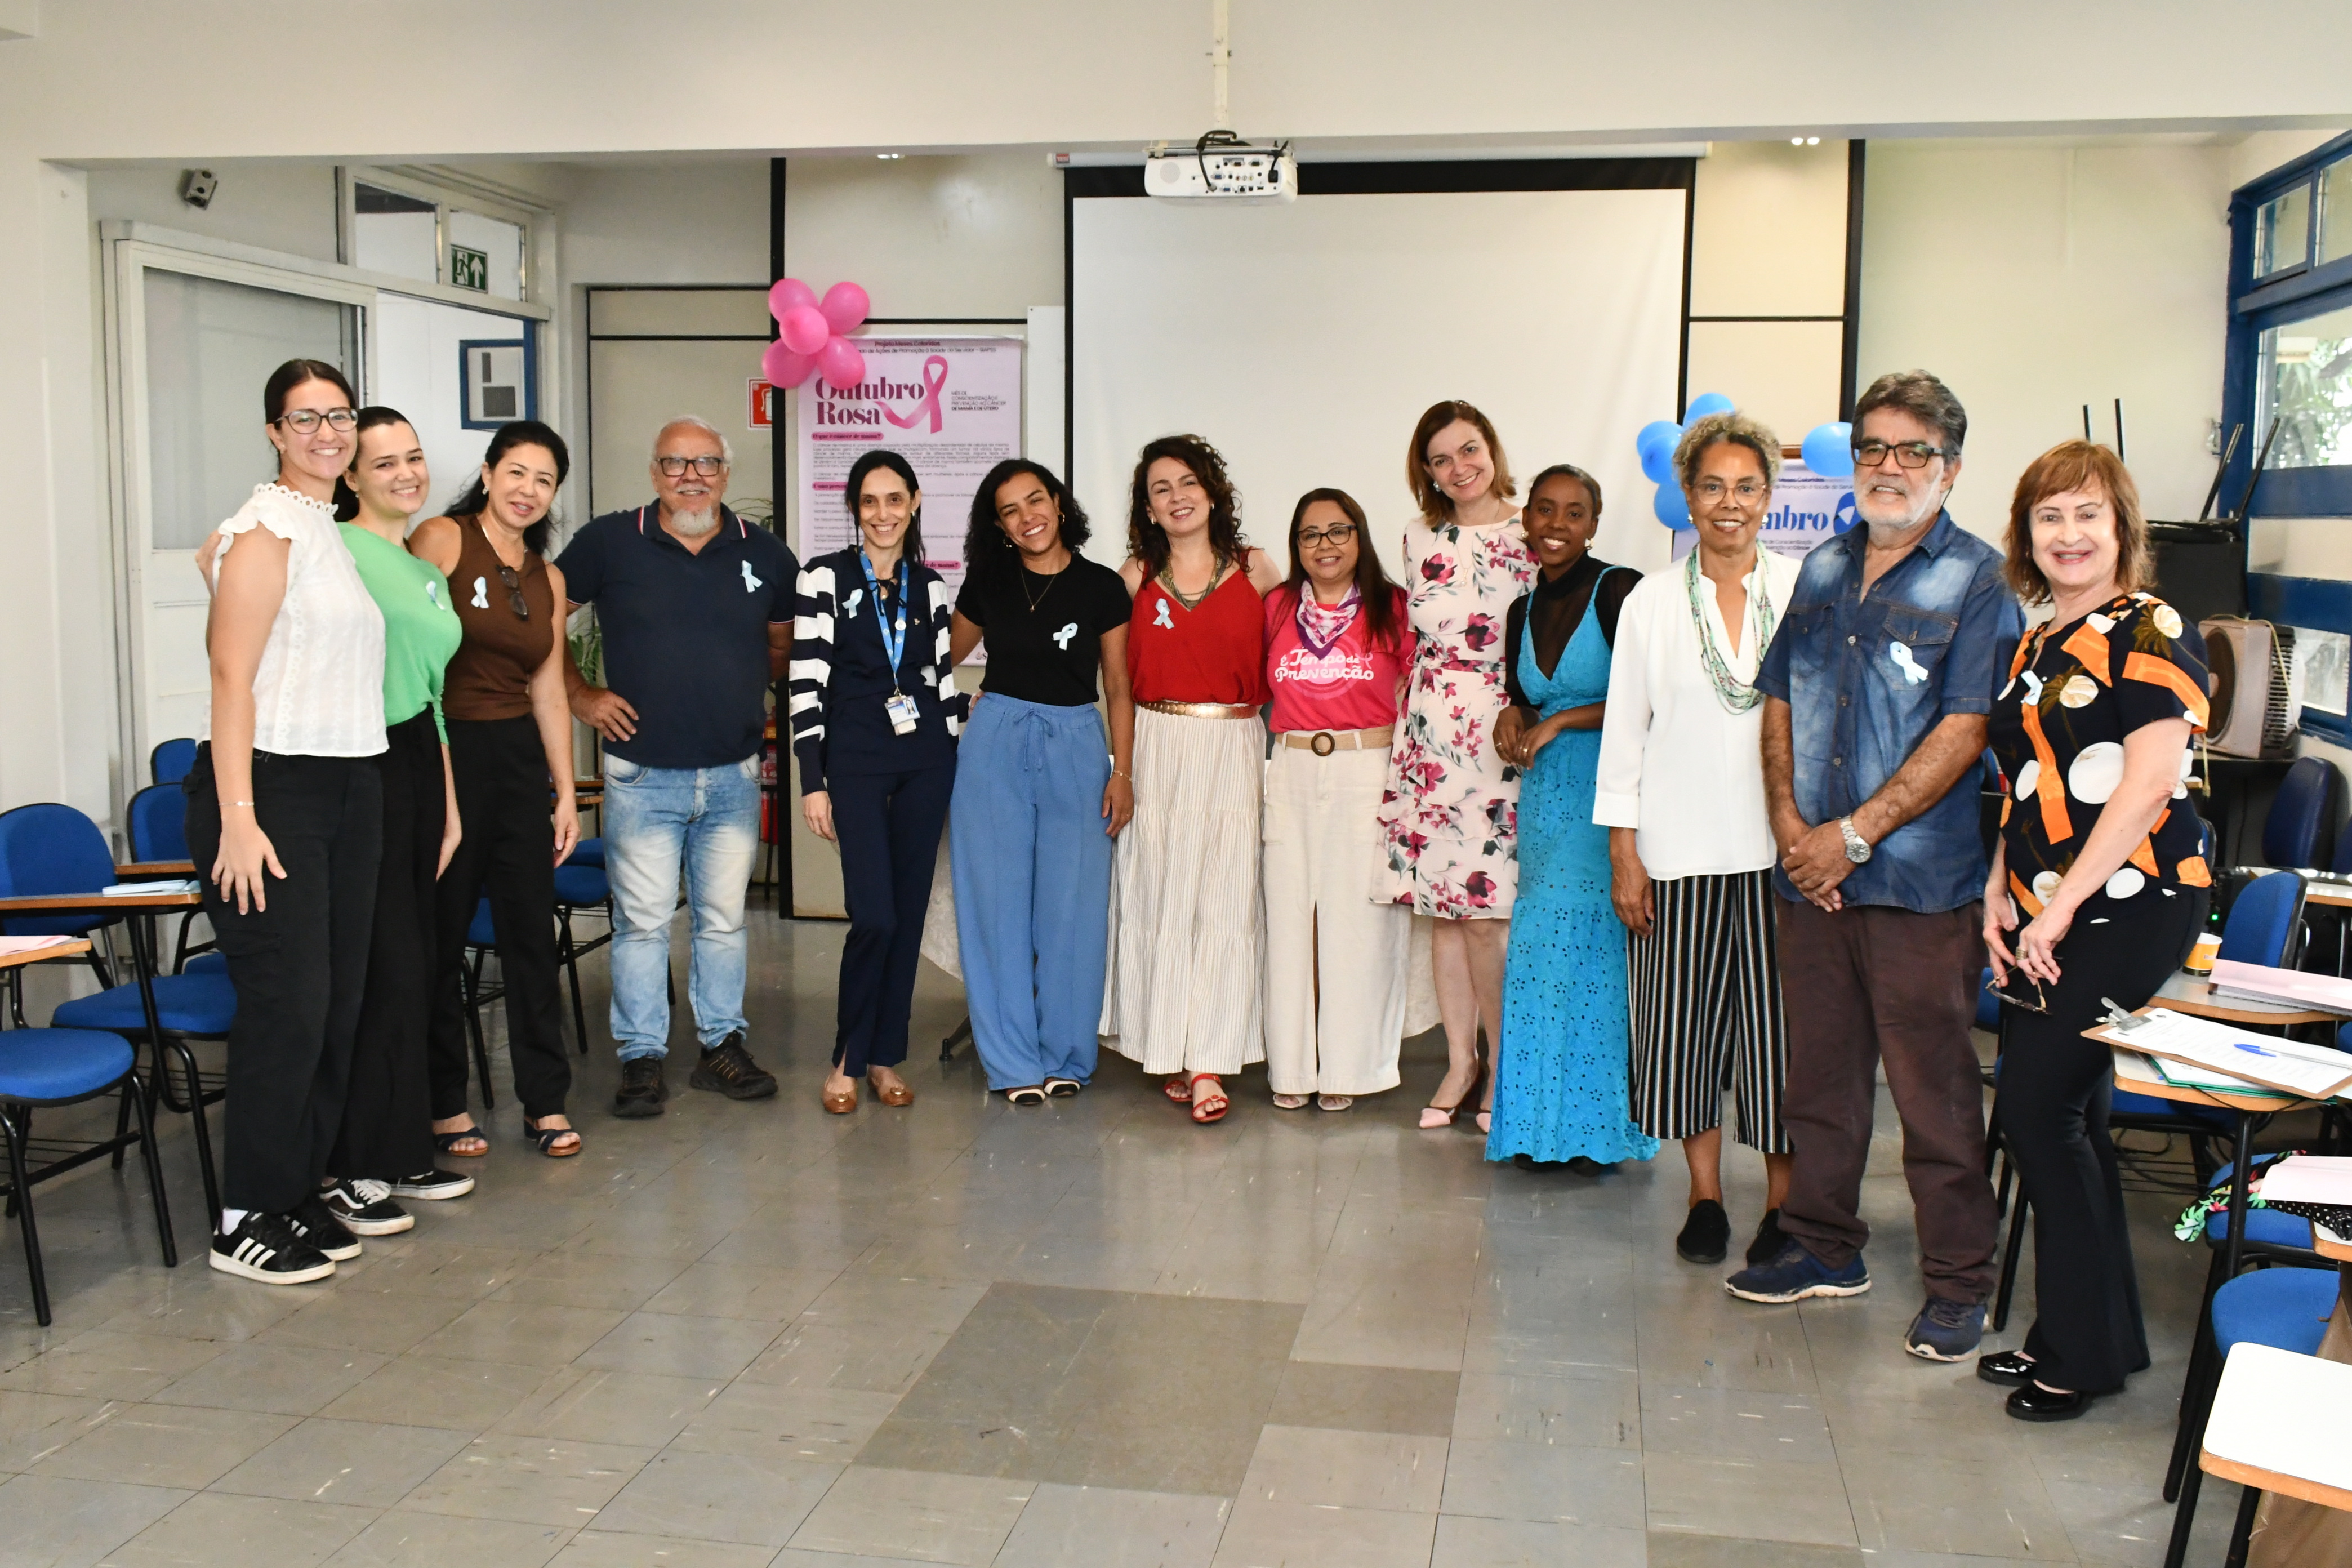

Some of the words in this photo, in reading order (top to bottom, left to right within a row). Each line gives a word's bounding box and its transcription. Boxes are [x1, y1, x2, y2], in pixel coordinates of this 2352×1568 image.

[815, 377, 924, 400] Outubro
[817, 401, 880, 425] Rosa
[1759, 505, 1828, 531] mbro
[1290, 649, 1346, 668] Tempo
[1346, 656, 1360, 664] de
[1275, 665, 1374, 682] Prevenção
